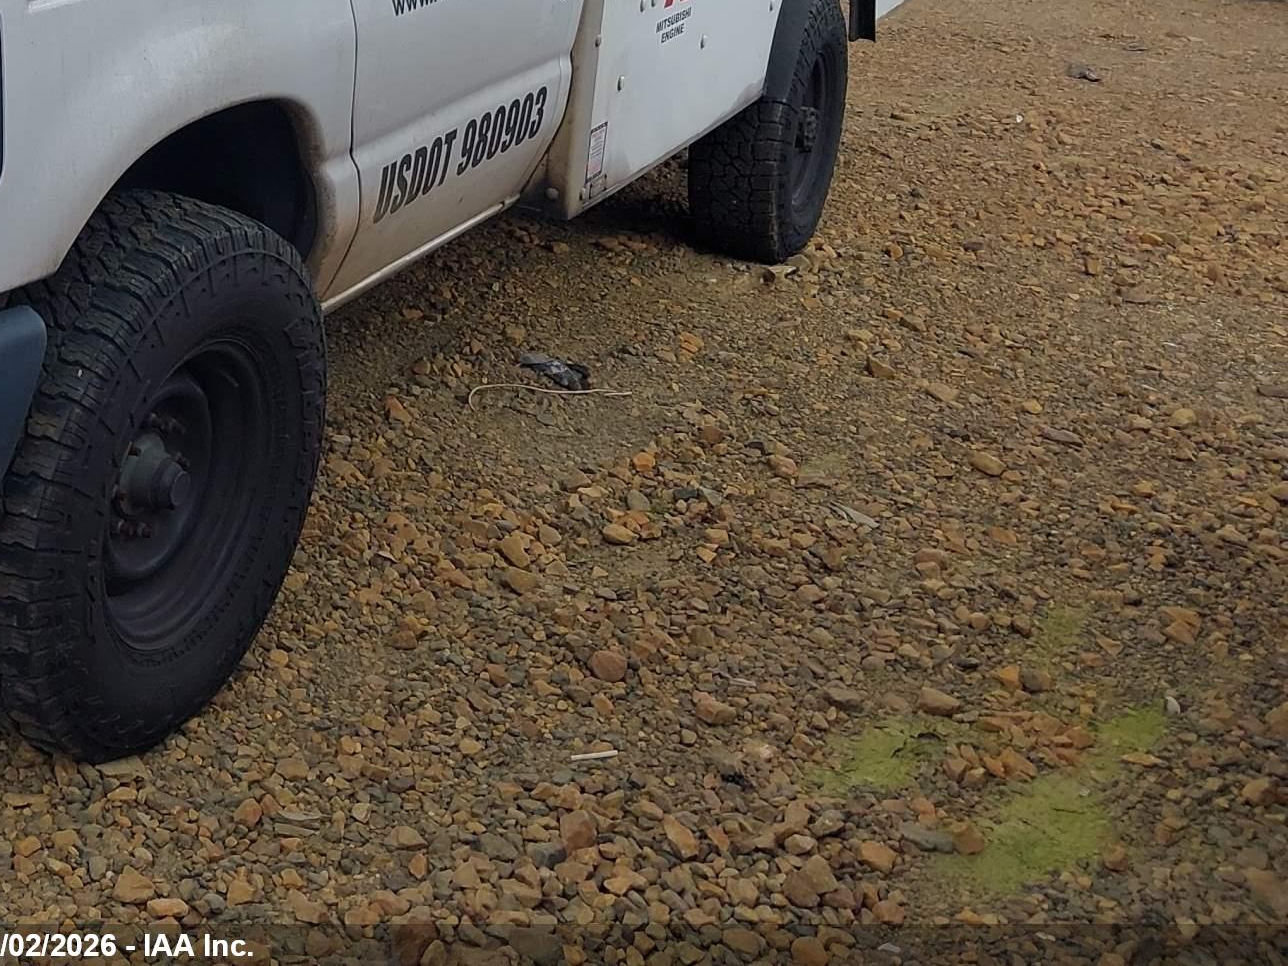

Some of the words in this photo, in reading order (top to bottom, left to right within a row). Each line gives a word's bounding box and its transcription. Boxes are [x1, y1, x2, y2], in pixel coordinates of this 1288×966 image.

[655, 7, 692, 33] MITSUBISHI
[661, 23, 685, 44] ENGINE
[372, 128, 458, 225] USDOT
[457, 86, 548, 176] 980903
